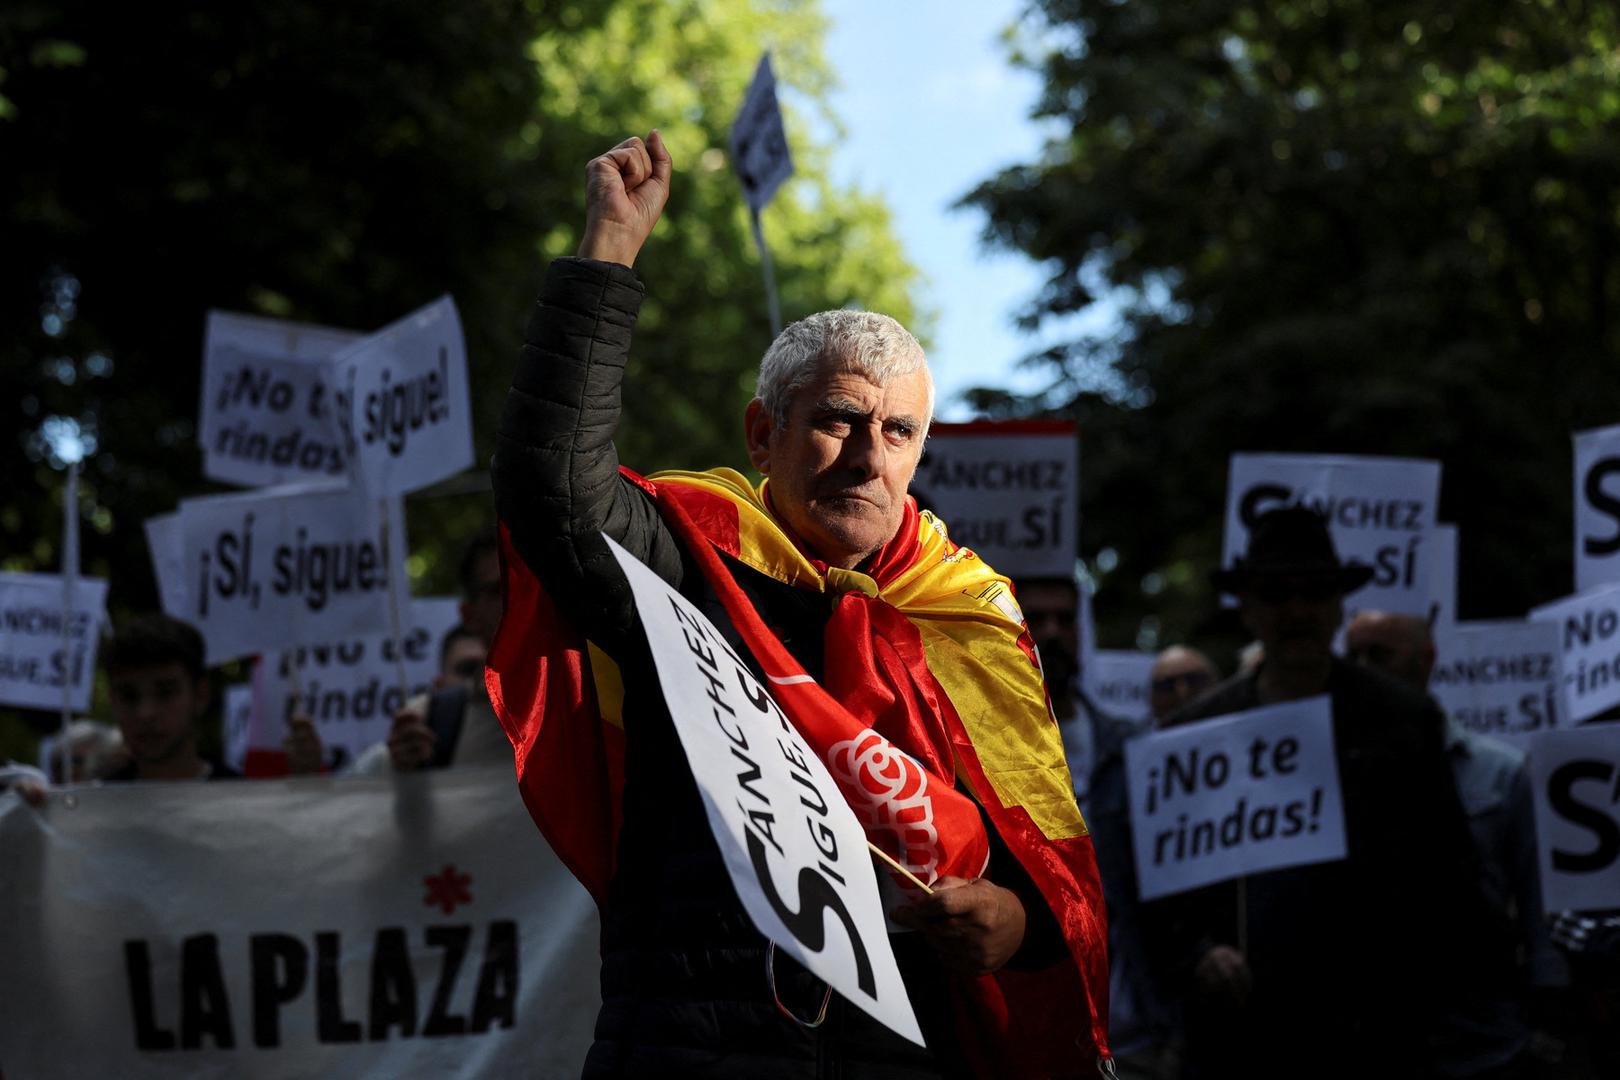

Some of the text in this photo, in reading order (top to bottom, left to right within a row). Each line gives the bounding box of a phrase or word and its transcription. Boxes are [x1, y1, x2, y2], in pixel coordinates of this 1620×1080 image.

[1147, 737, 1298, 814] ¡No te
[1154, 788, 1322, 865] rindas!
[124, 919, 520, 1050] LA PLAZA
